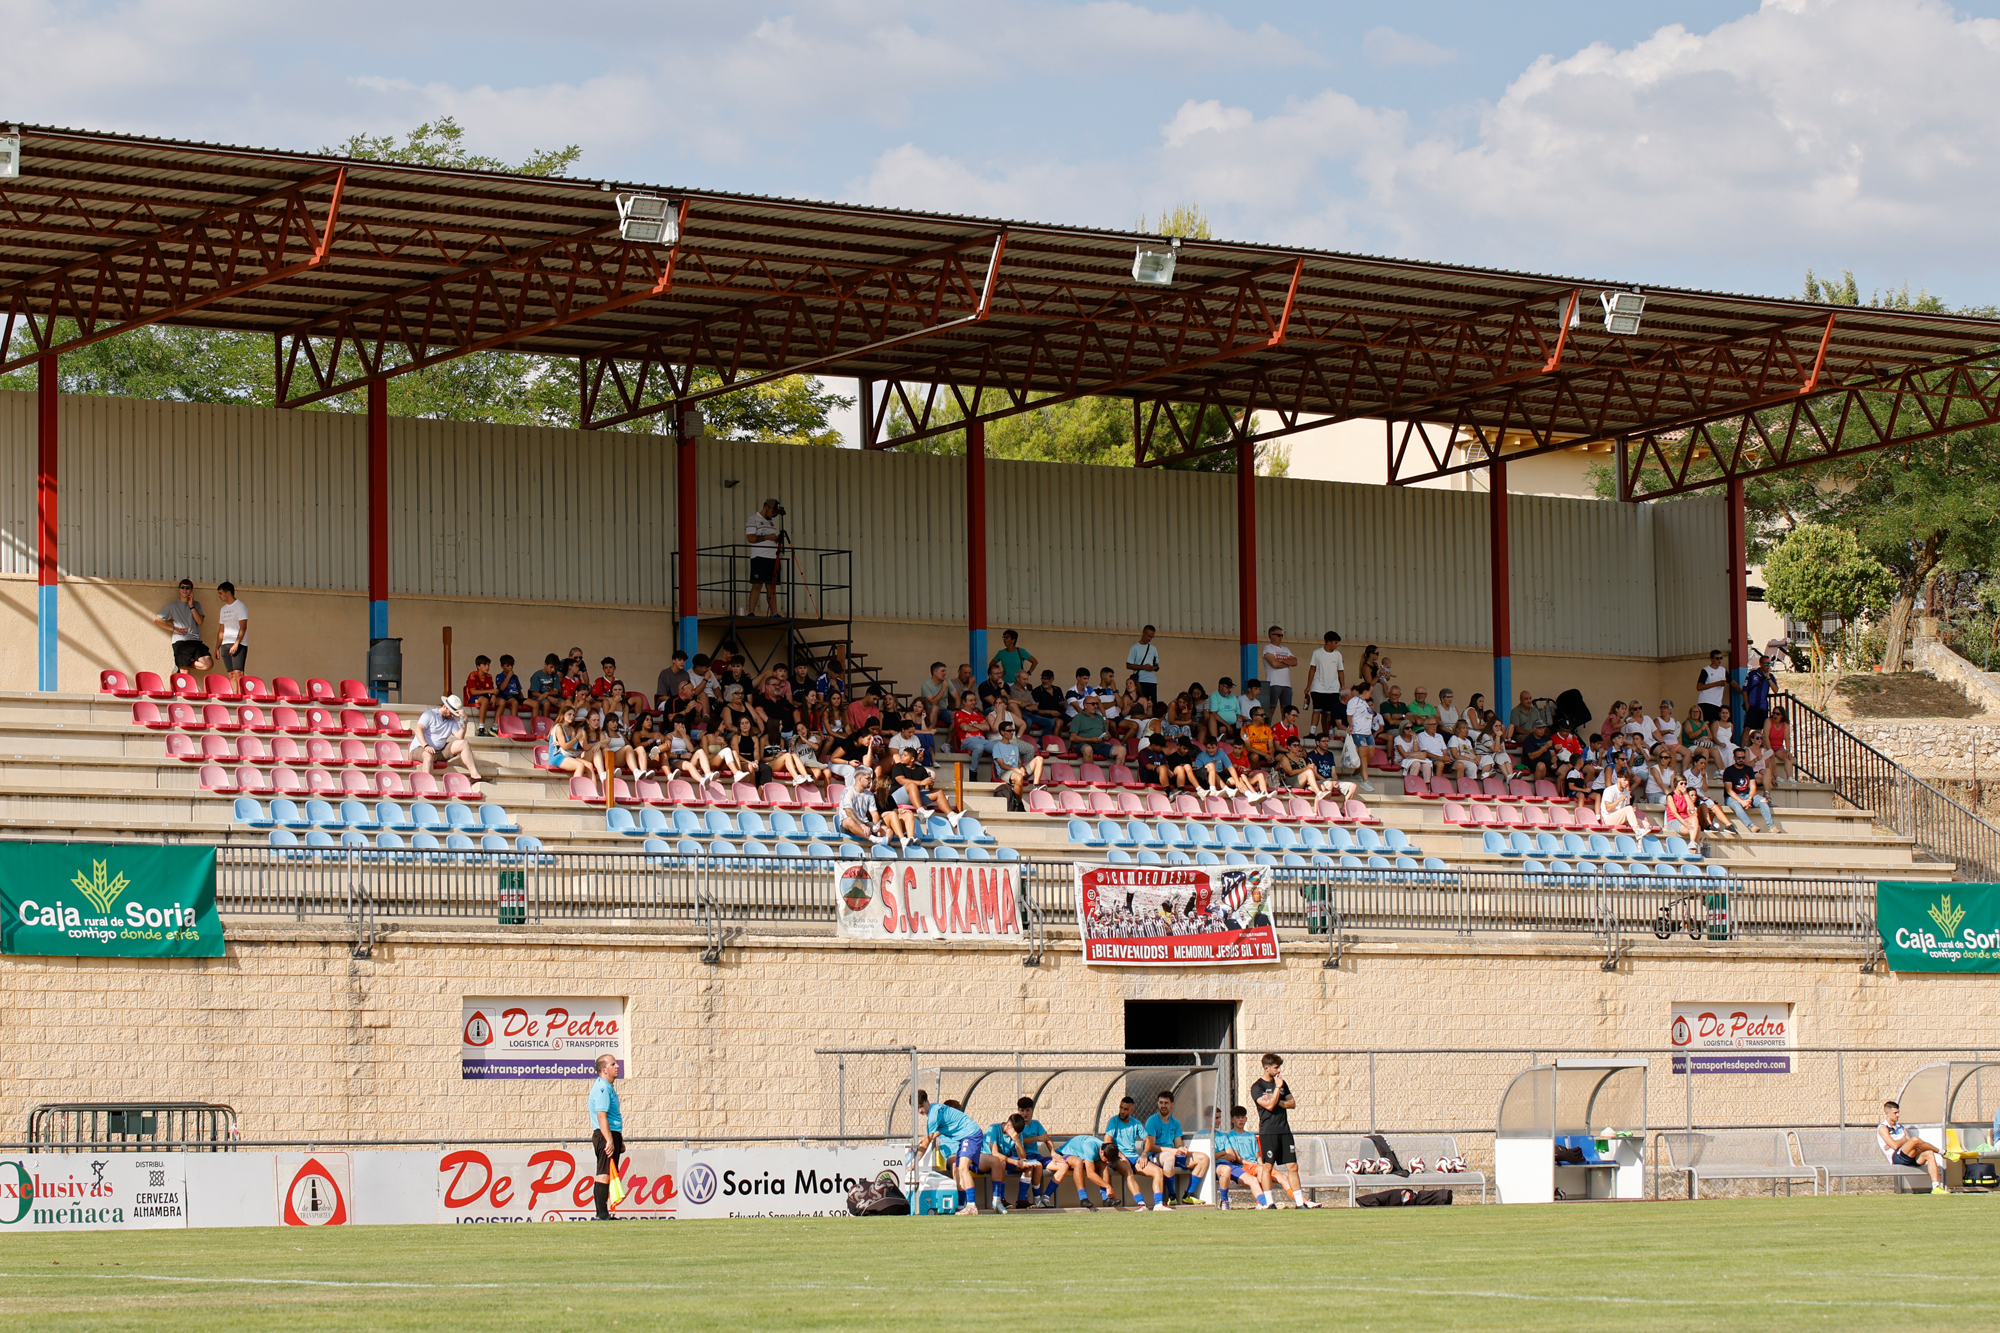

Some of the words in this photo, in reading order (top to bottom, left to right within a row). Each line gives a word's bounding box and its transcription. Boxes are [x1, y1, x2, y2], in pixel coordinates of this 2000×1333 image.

[881, 865, 928, 934] S.C.
[931, 866, 1020, 935] UXAMA
[19, 900, 80, 932] Caja
[84, 917, 108, 927] rural
[110, 918, 124, 927] de
[125, 902, 197, 928] Soria
[68, 927, 117, 943] contigo
[120, 928, 162, 940] donde
[165, 928, 200, 941] estés
[1895, 928, 1936, 953] Caja
[1938, 941, 1954, 949] rural
[1955, 941, 1964, 949] de
[1092, 943, 1169, 959] ¡BIENVENIDOS!
[1174, 945, 1215, 959] MEMORIAL
[1216, 942, 1240, 959] JESÚS
[1241, 944, 1253, 957] GIL
[1254, 943, 1263, 957] Y
[1262, 943, 1275, 957] GIL
[1929, 949, 1962, 962] contigo
[1963, 950, 1991, 959] donde
[502, 1008, 539, 1036] De
[545, 1008, 619, 1038] Pedro
[1698, 1012, 1725, 1037] De
[1730, 1011, 1786, 1037] Pedro
[509, 1040, 549, 1048] LOGISTICA
[565, 1040, 619, 1048] TRANSPORTES
[0, 1174, 114, 1200] xclusivas
[439, 1150, 514, 1208] De
[527, 1150, 678, 1210] Pero
[723, 1170, 785, 1195] Soria
[136, 1193, 179, 1204] CERVEZAS
[133, 1206, 182, 1218] ALHAMBRA
